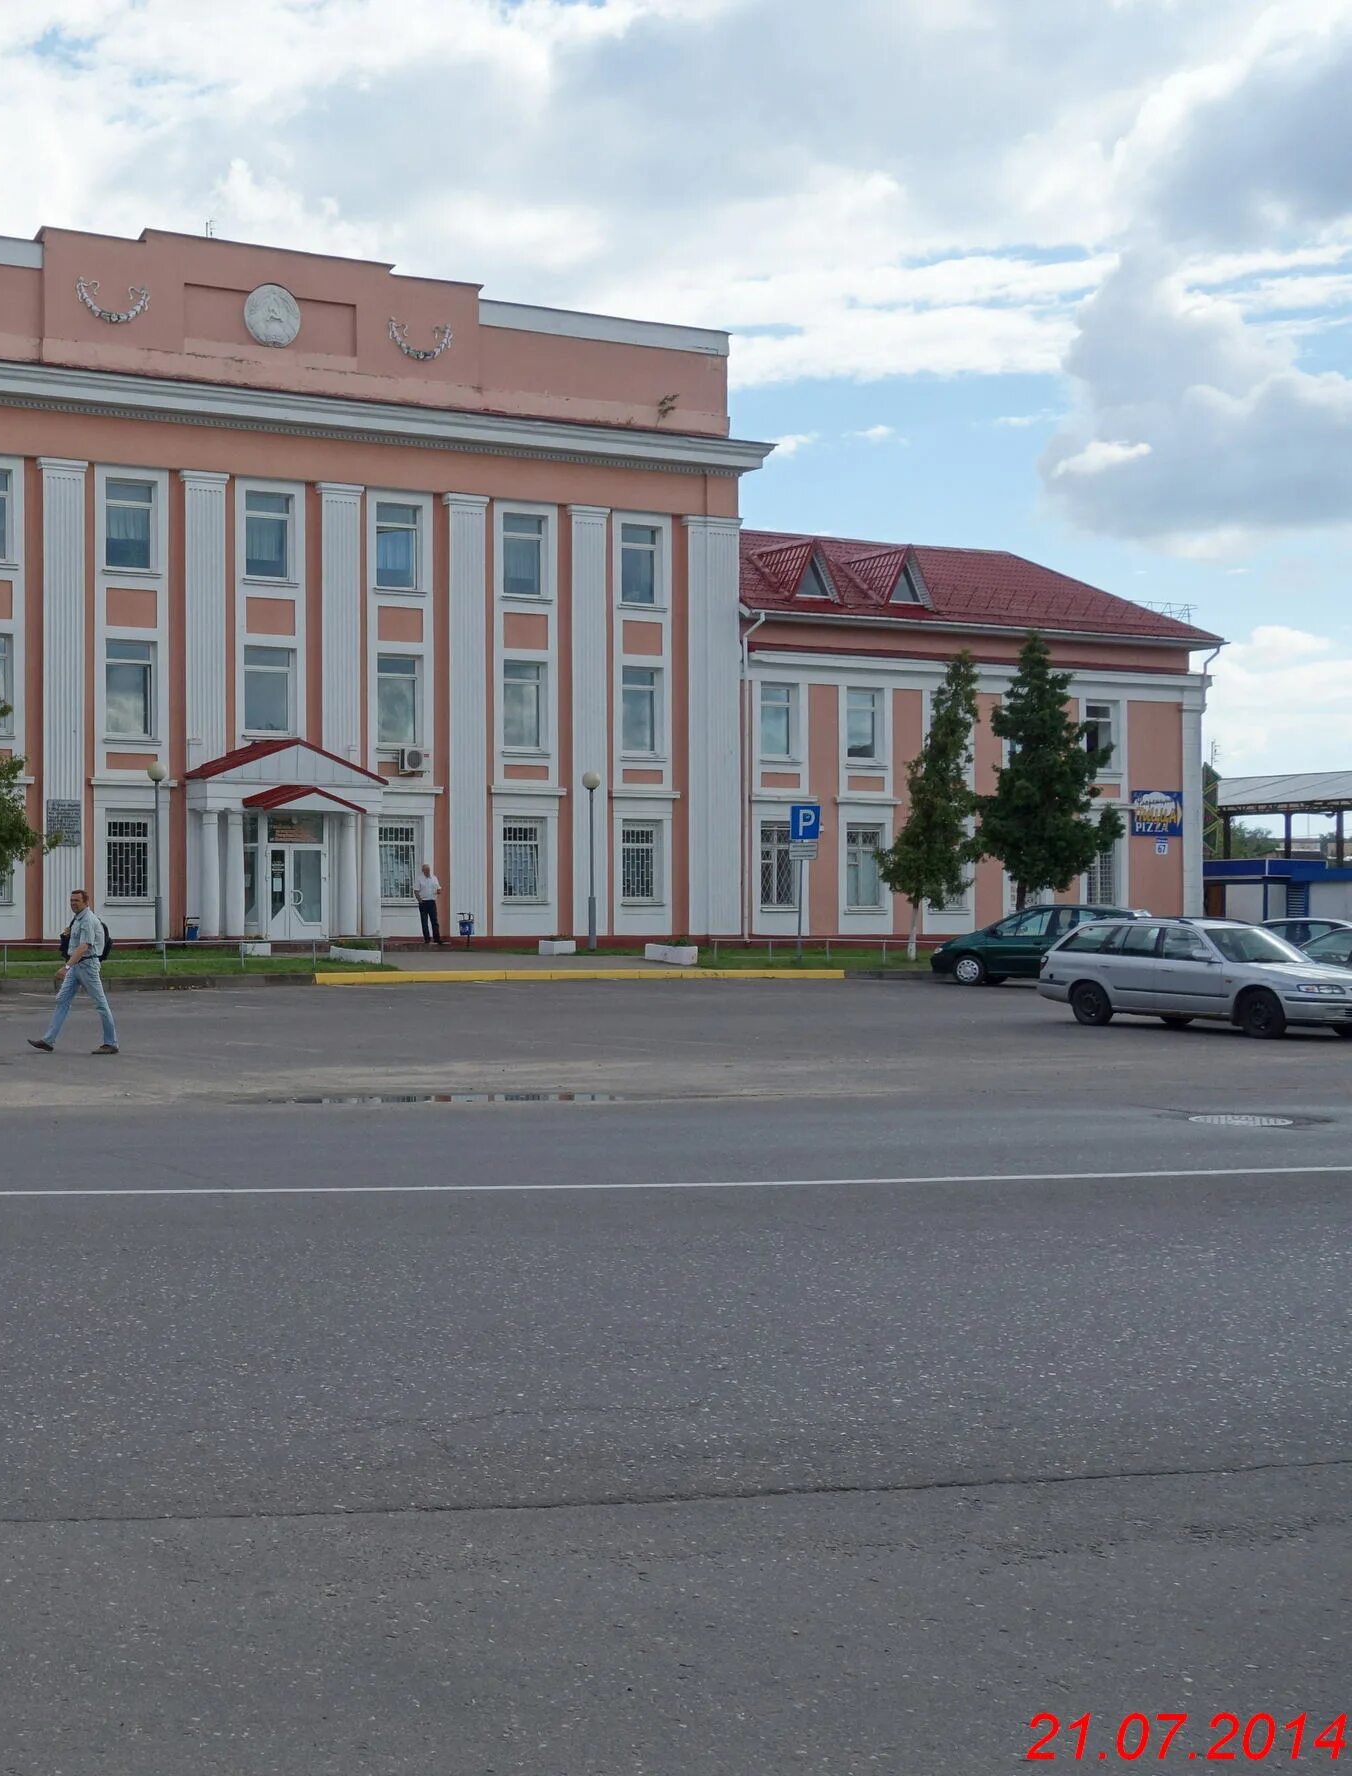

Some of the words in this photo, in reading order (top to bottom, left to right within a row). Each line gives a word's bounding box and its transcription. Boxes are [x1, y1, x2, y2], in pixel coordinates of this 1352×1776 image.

[799, 809, 815, 836] P
[1135, 822, 1168, 832] PIZZA
[1157, 845, 1166, 853] 67
